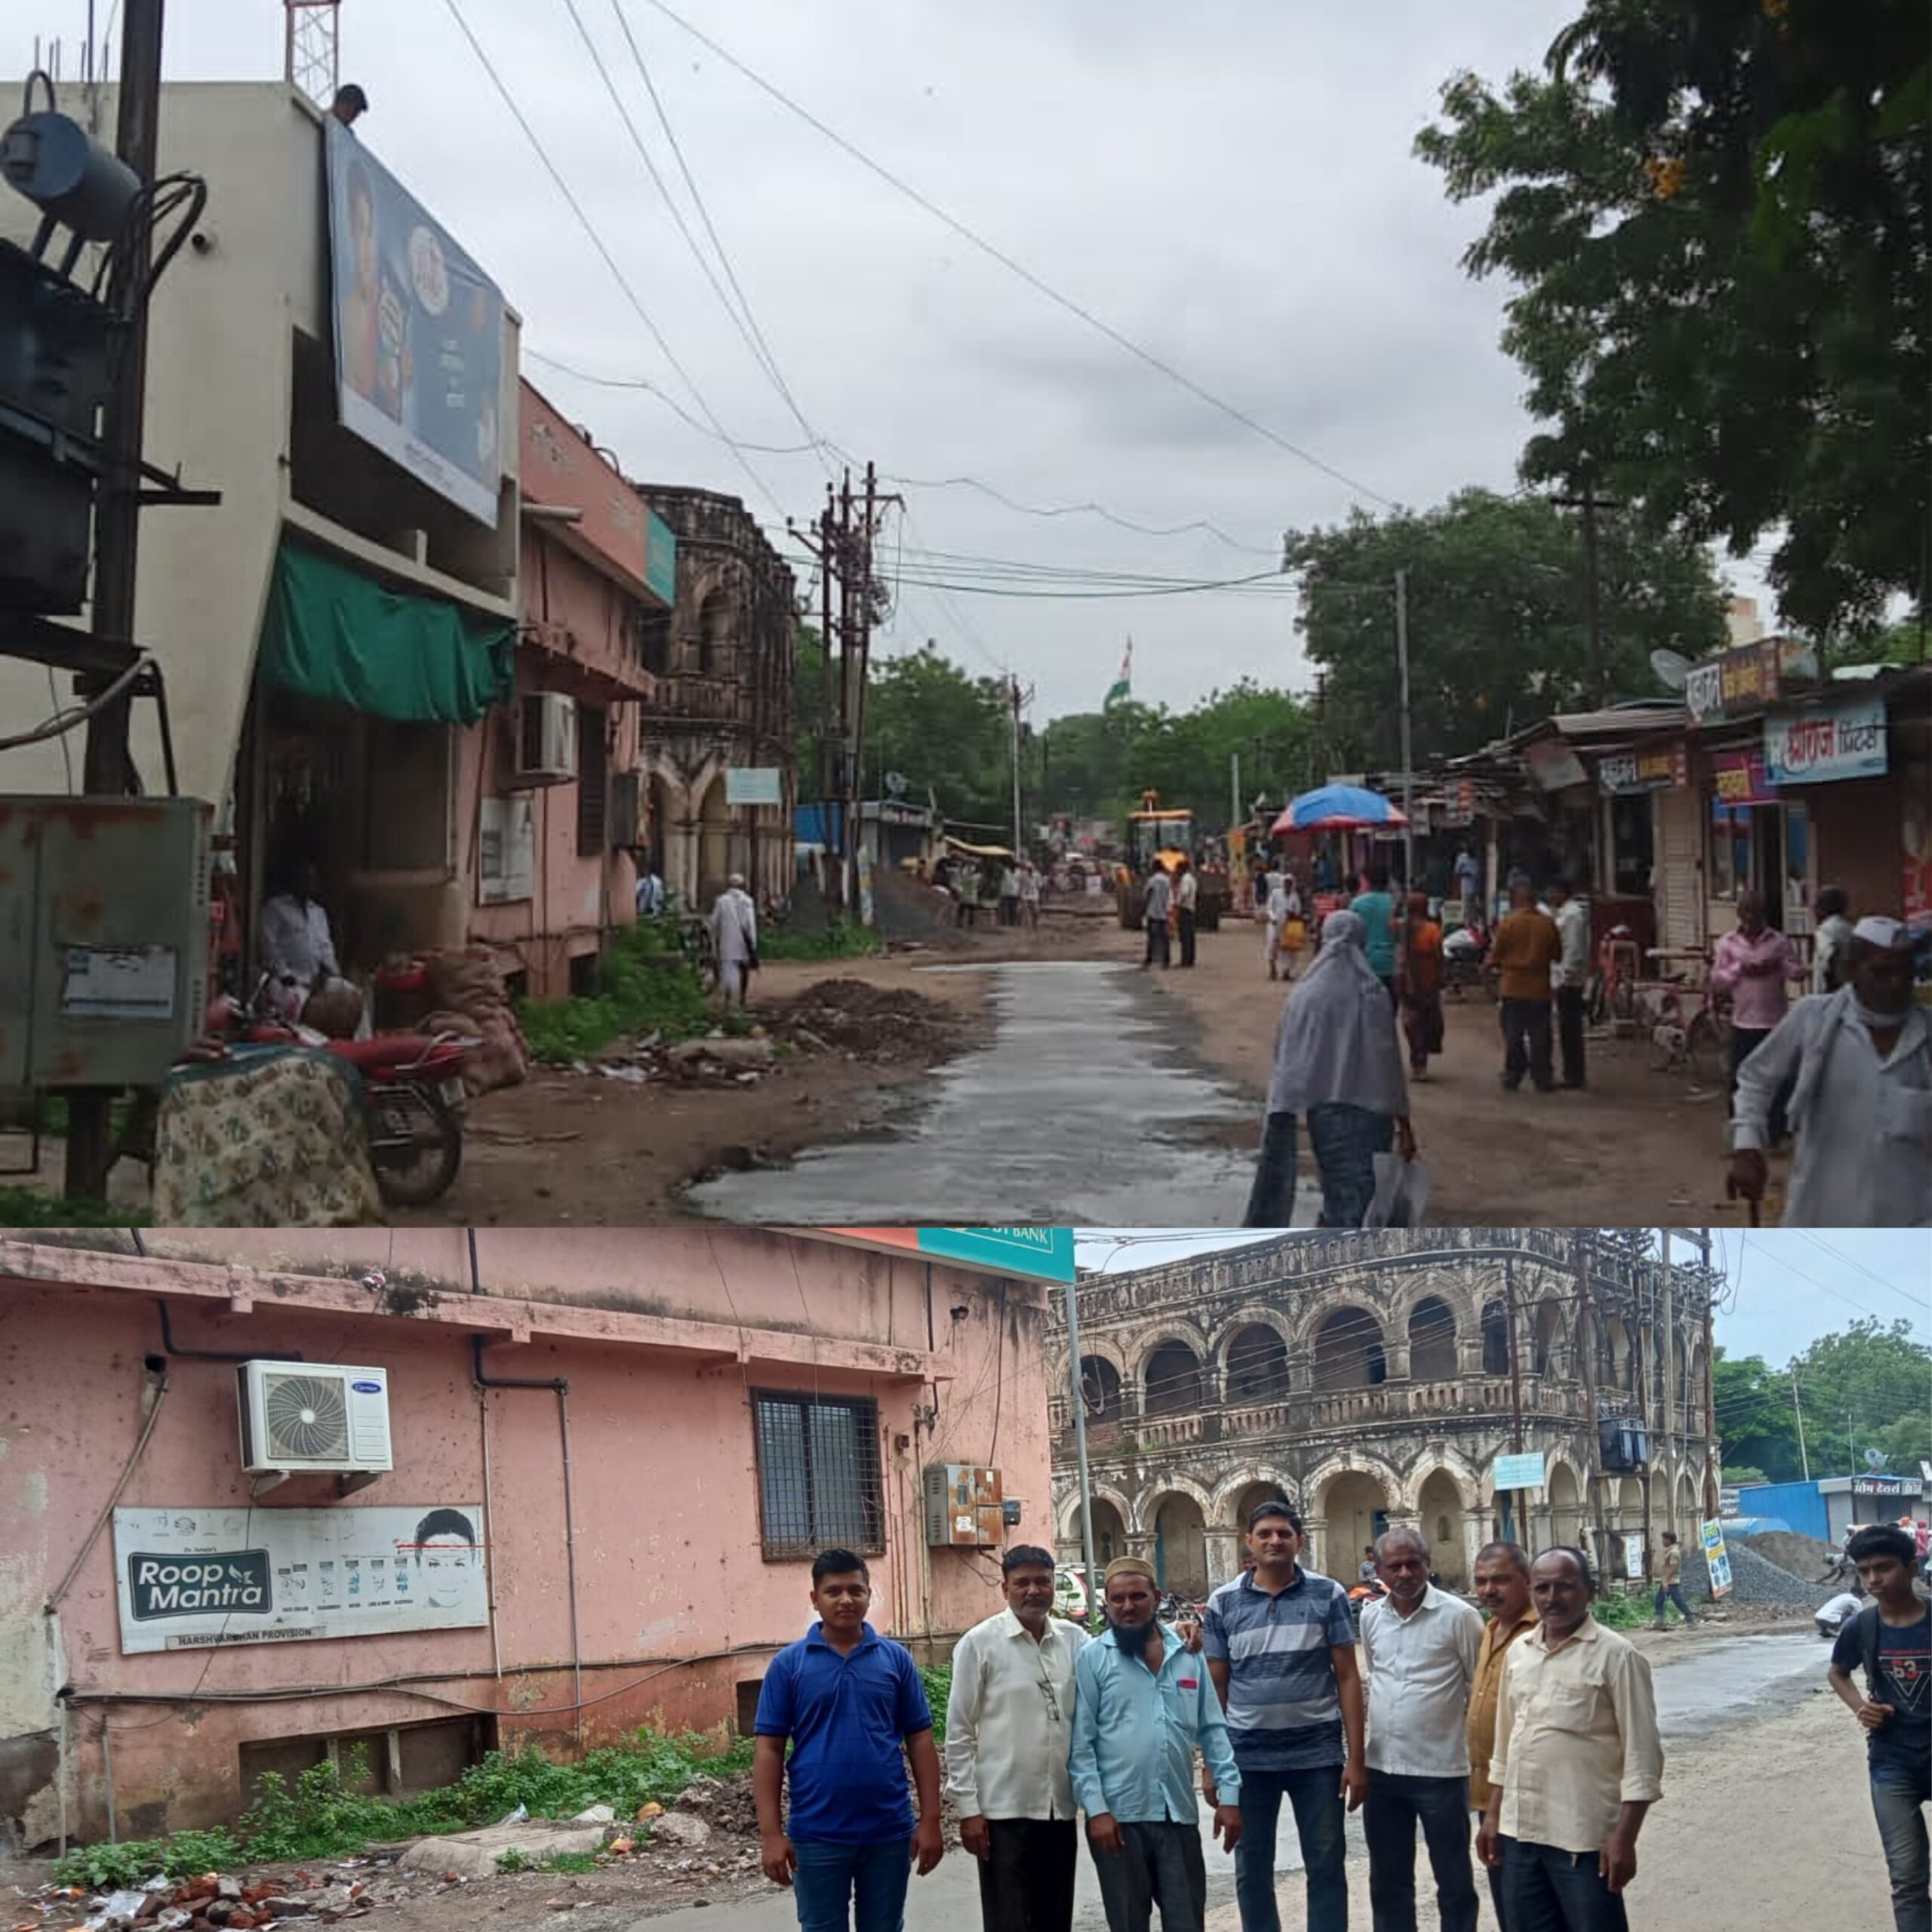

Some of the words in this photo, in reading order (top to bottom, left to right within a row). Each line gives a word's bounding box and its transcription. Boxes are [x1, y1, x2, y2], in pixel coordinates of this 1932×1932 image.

[1013, 1228, 1048, 1244] BANK
[139, 1561, 224, 1588] Roop
[149, 1583, 263, 1611] Mantra
[261, 1628, 311, 1640] PROVISION
